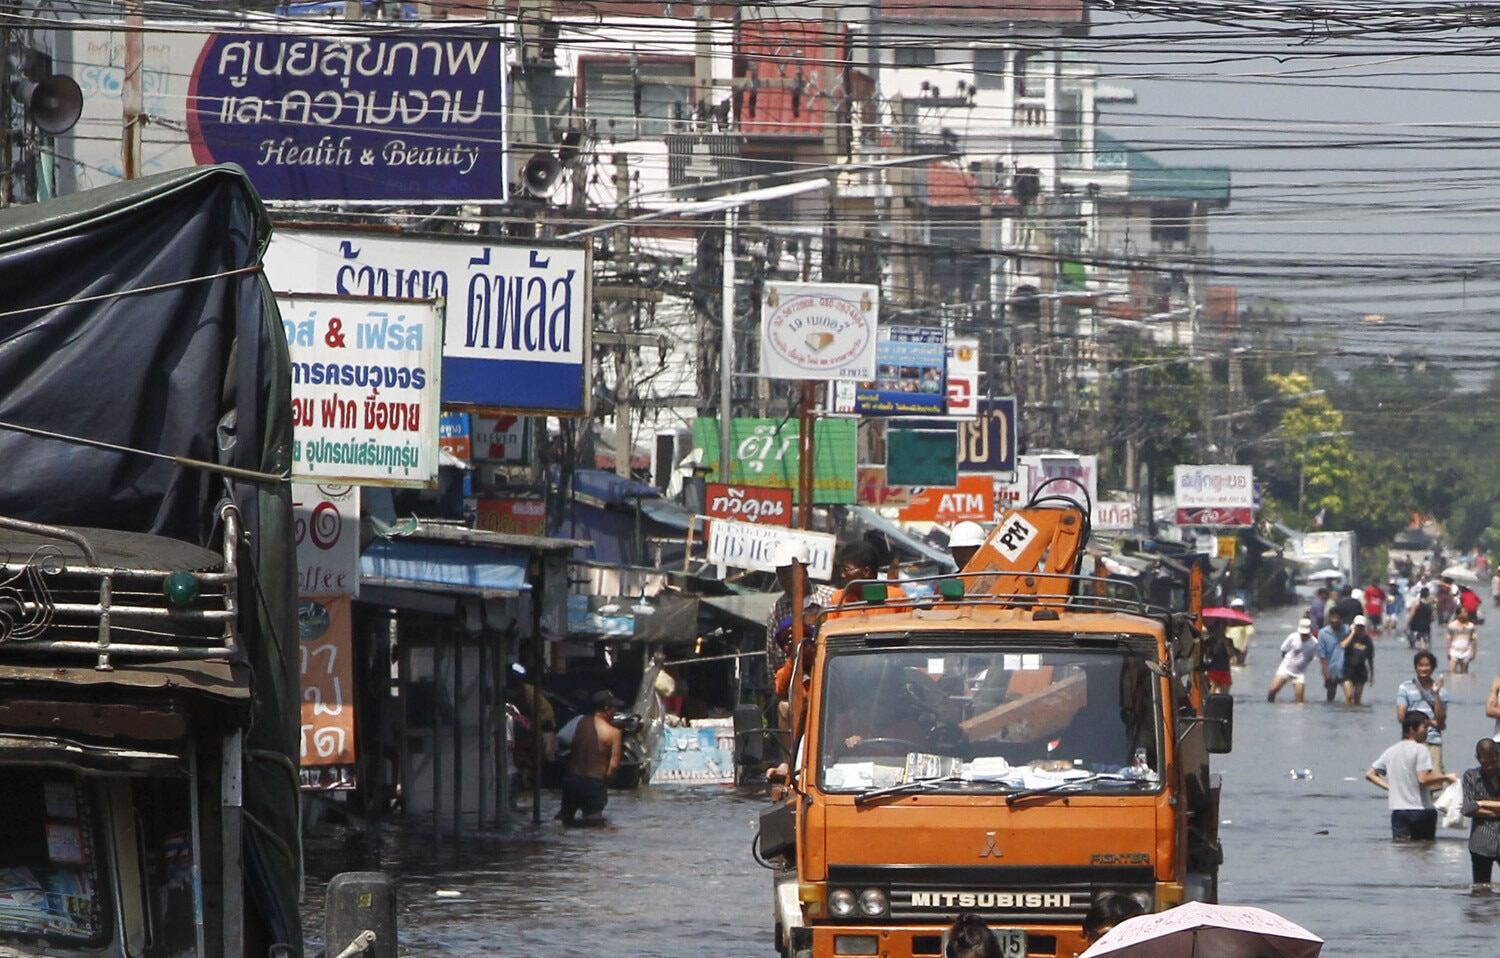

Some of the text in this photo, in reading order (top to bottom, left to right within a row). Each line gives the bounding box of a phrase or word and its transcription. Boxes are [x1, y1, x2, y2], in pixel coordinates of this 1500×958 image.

[218, 40, 489, 89] ศูนยสุขภาพ
[219, 89, 485, 125] และ ความงาม
[256, 136, 481, 175] Health & Beauty
[464, 246, 577, 353] ดีพลัส
[324, 316, 346, 349] &
[355, 310, 424, 352] เฟิร์ส
[321, 392, 357, 430] ฝาก
[363, 387, 421, 433] ซื้อขาย
[711, 487, 784, 523] ทวีคูณ
[937, 493, 984, 512] ATM
[1000, 519, 1030, 552] PM
[911, 891, 1071, 909] MITSUBISHI
